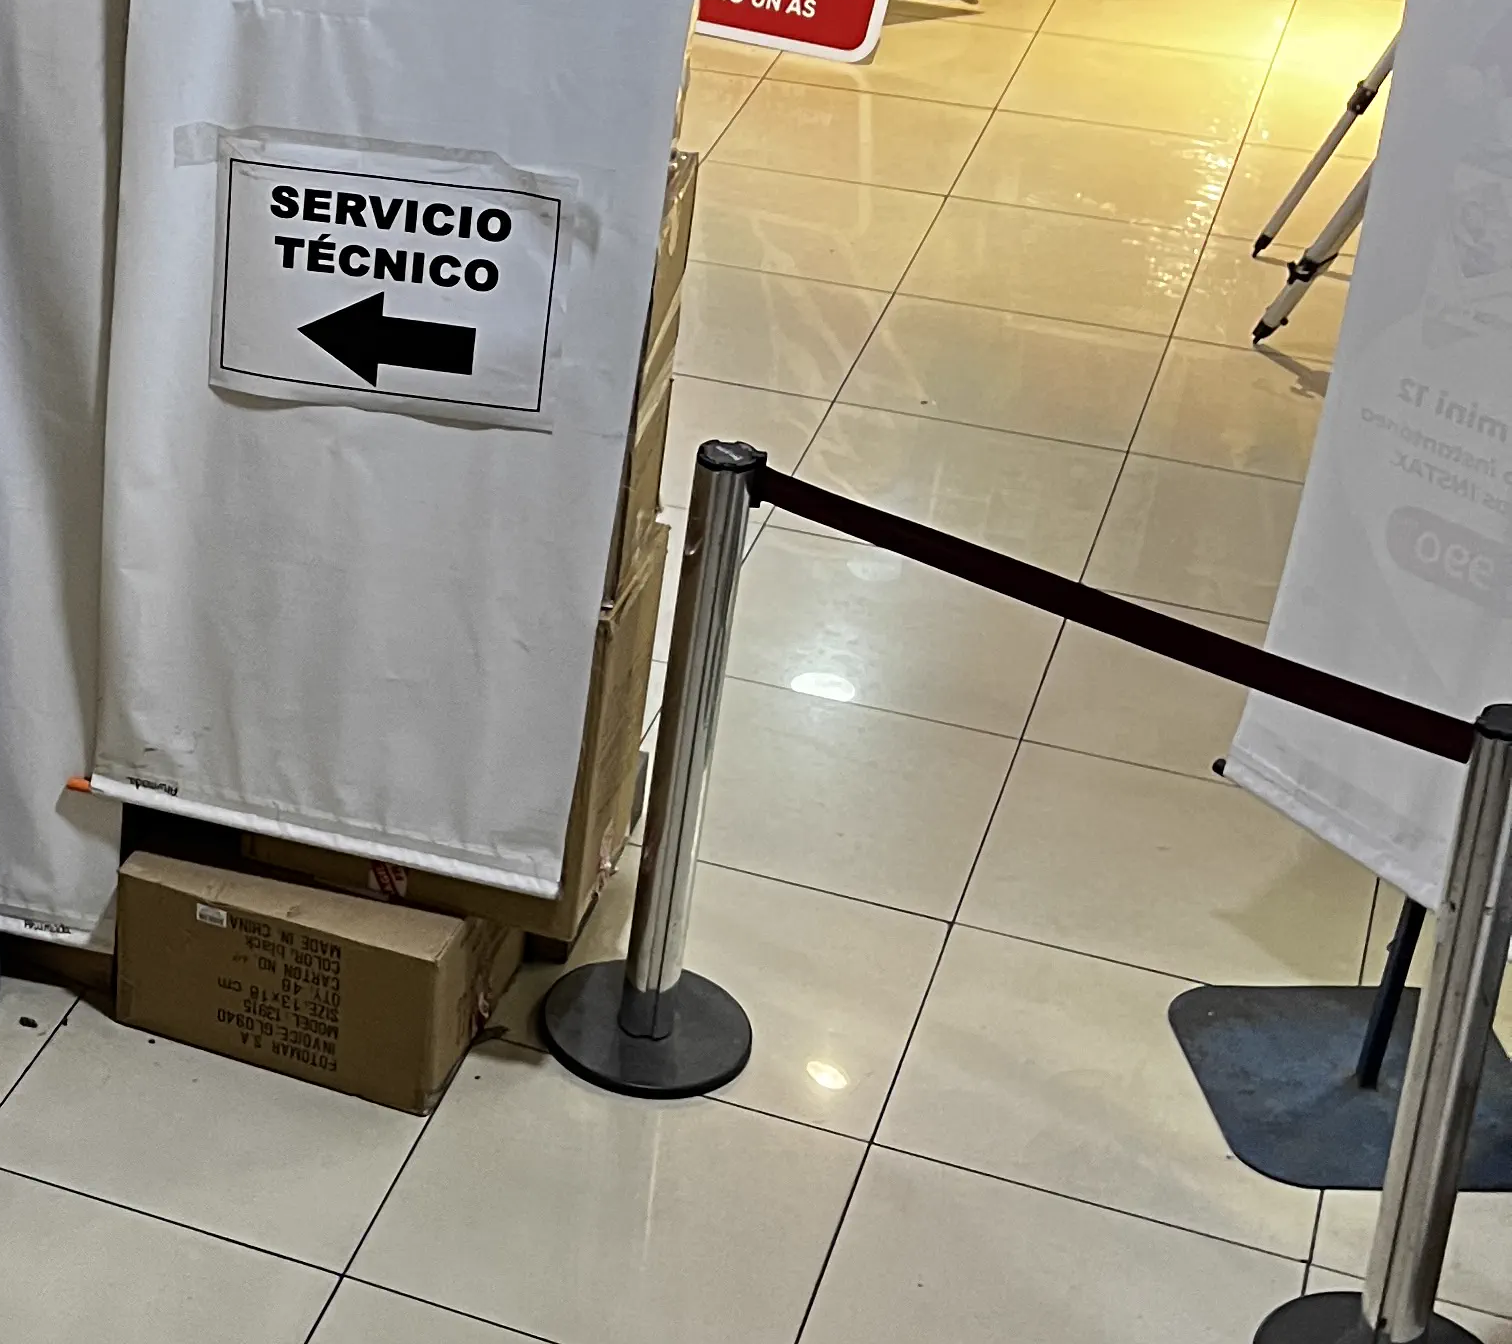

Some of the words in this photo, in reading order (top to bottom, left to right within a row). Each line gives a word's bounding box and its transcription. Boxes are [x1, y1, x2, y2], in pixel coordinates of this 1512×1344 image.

[270, 185, 513, 243] SERVICIO
[274, 234, 500, 293] TÉCNICO
[229, 915, 272, 938] CHINA
[280, 931, 294, 945] IN
[301, 936, 341, 960] MADE
[217, 976, 242, 992] cm
[284, 964, 340, 991] CARTON
